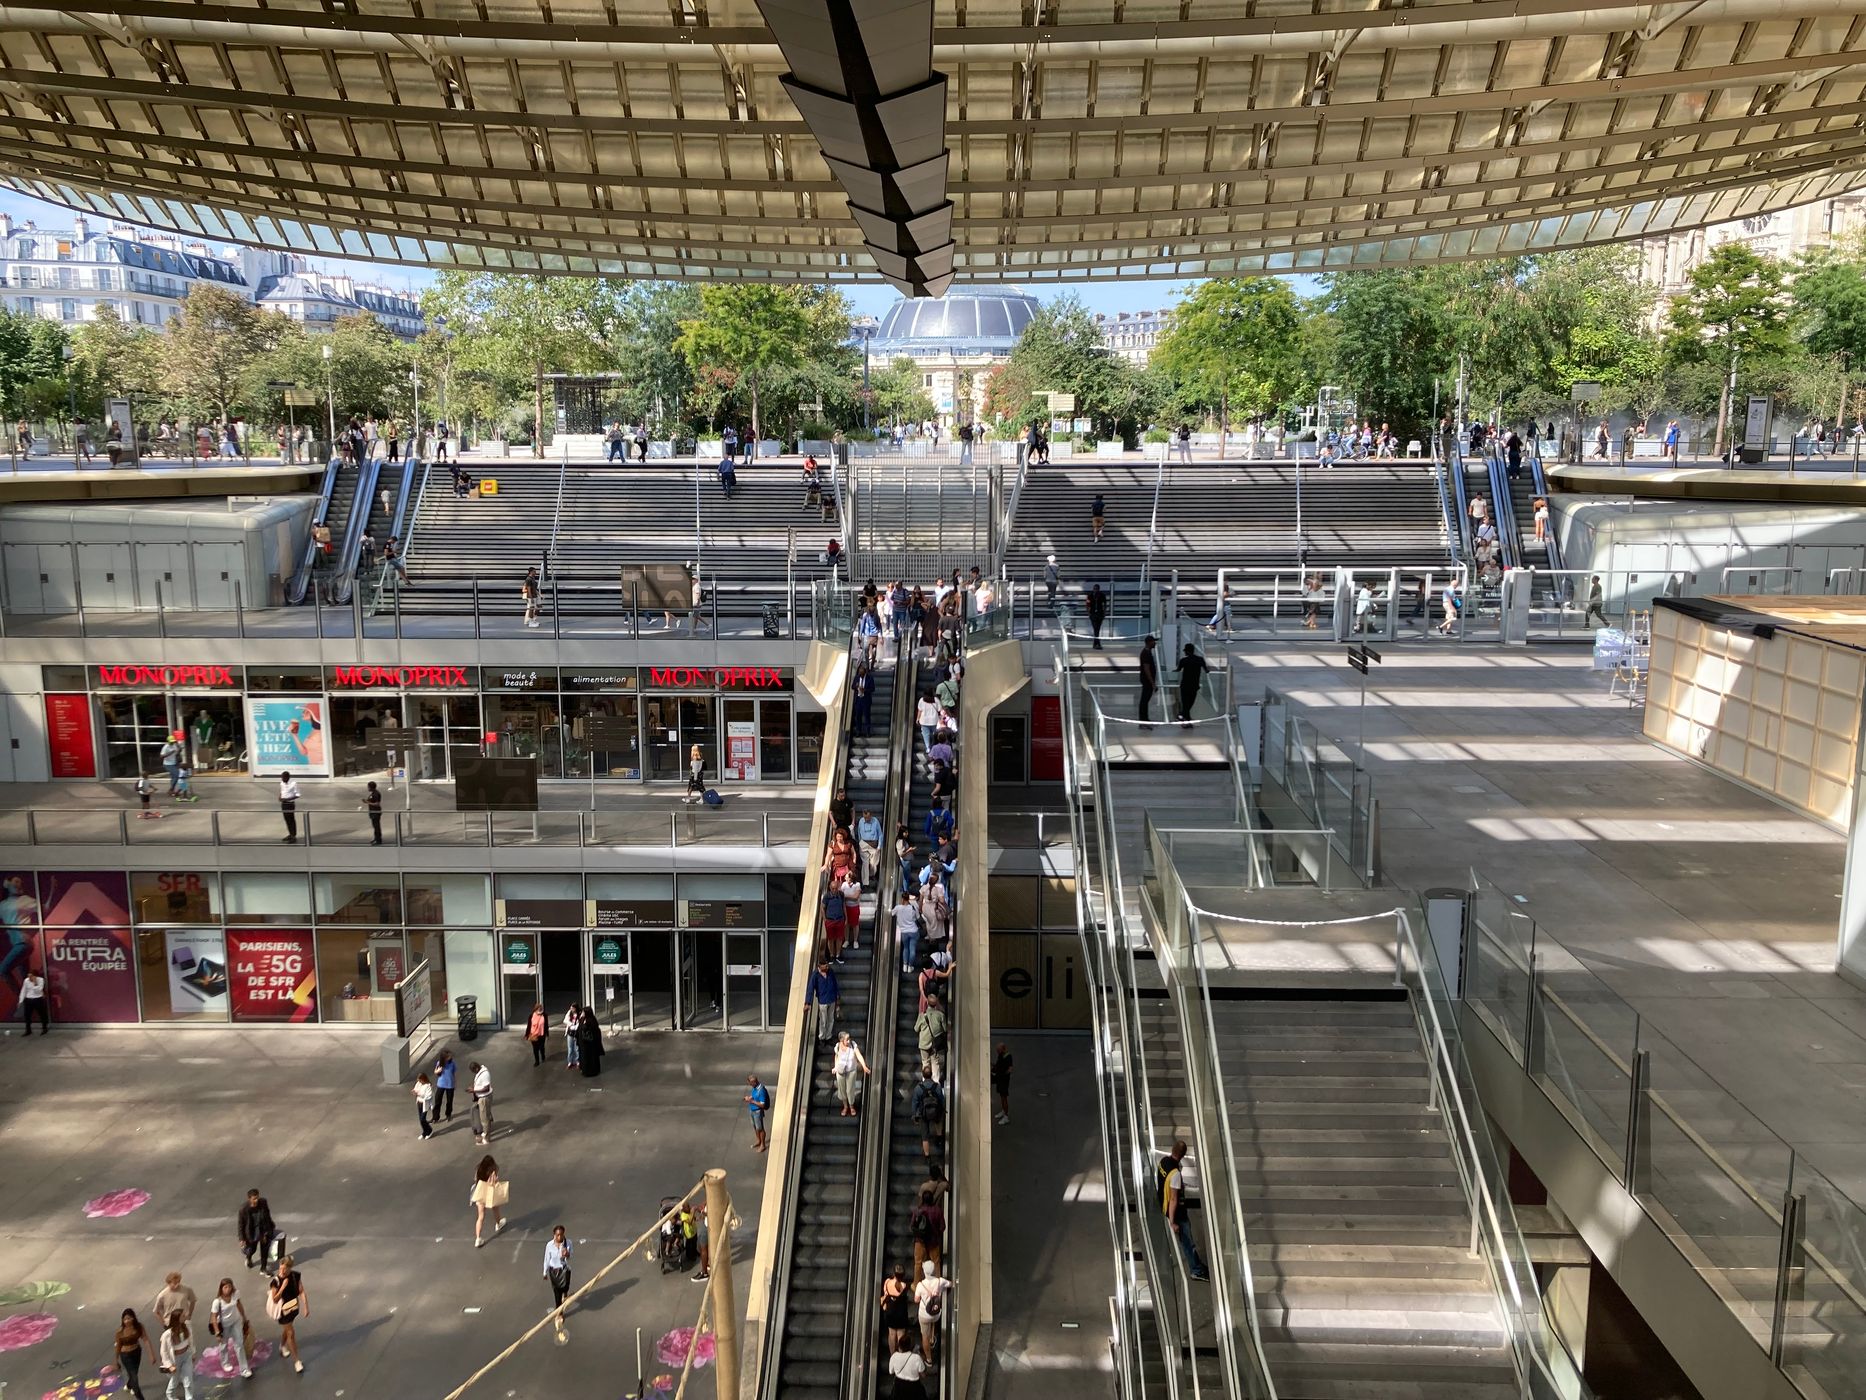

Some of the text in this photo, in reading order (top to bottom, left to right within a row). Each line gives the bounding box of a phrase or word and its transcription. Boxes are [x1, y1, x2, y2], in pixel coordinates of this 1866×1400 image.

[100, 664, 234, 686] MONOPRIX
[335, 665, 468, 687] MONOPRIX
[503, 671, 537, 680] mode &
[573, 675, 627, 684] alimentation
[650, 666, 783, 687] MONOPRIX
[505, 679, 534, 687] beauté
[158, 873, 201, 892] SFR
[52, 937, 110, 946] MA RENTRÉE
[239, 942, 303, 953] PARISIENS,
[52, 947, 126, 961] ULTRA
[82, 960, 128, 972] ÉQUIPÉE
[237, 954, 302, 973] LA 5G
[247, 976, 295, 987] DE SFR
[1000, 956, 1073, 999] eli
[249, 987, 295, 1000] EST LÀ
